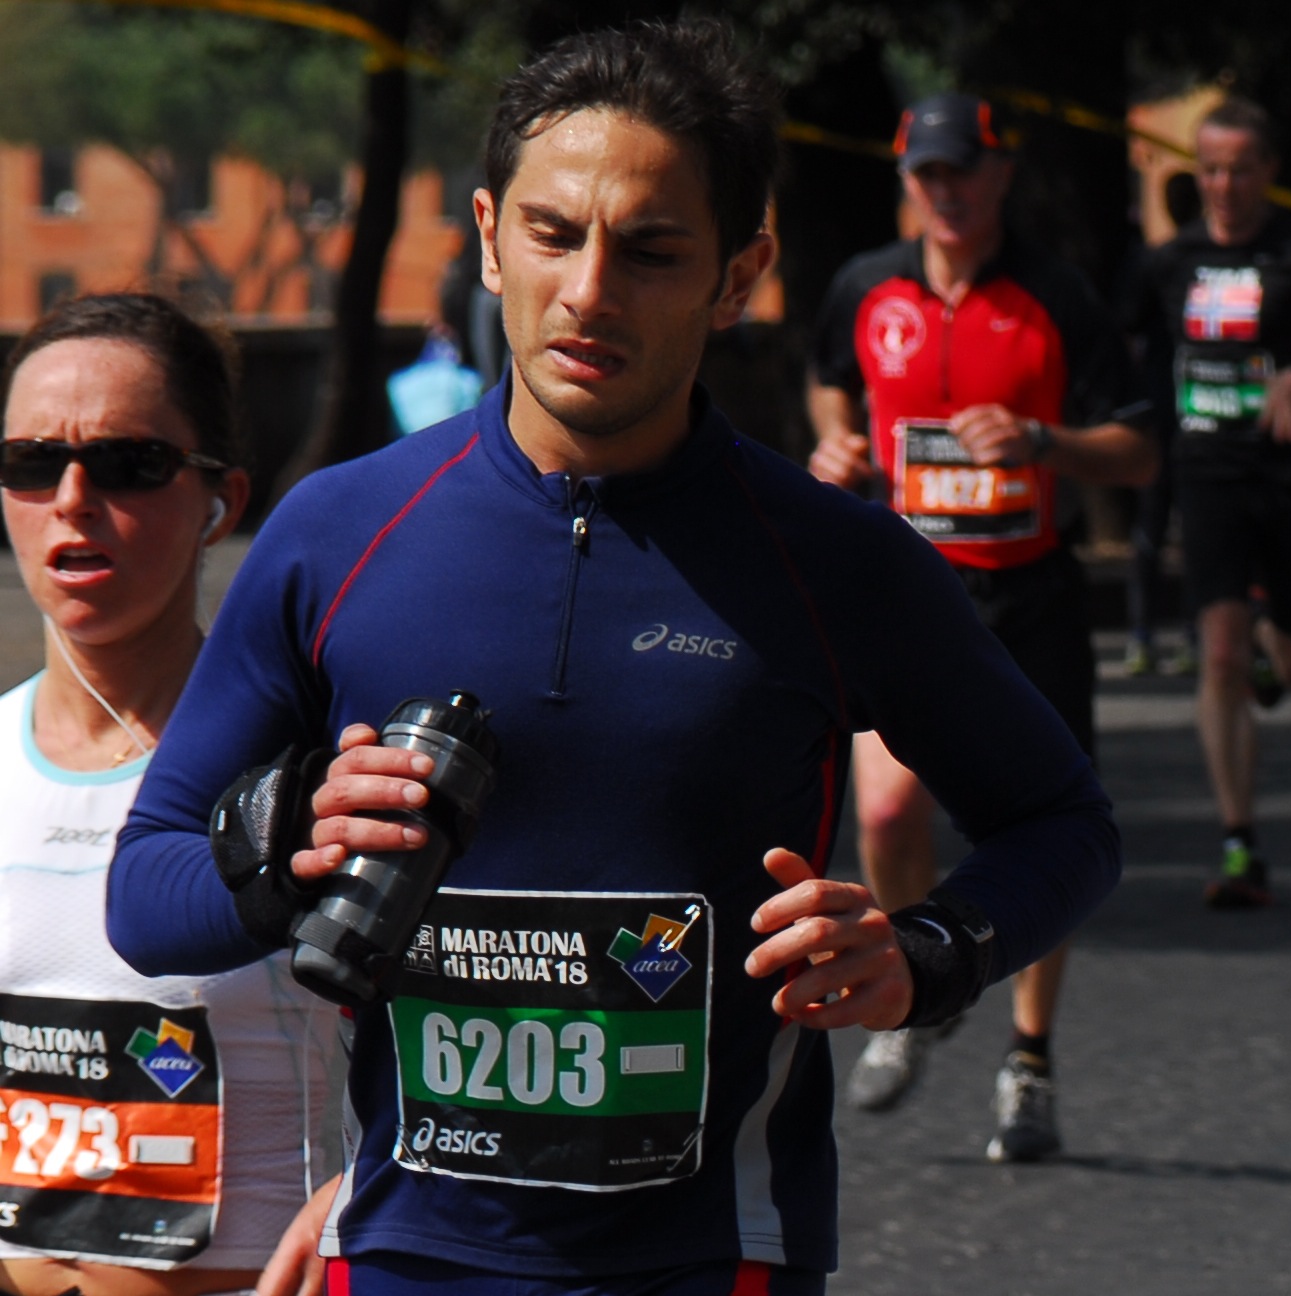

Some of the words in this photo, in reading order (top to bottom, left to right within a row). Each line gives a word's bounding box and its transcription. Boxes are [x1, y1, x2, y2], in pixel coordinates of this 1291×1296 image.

[441, 927, 587, 957] MARATONA
[443, 954, 468, 979] di
[633, 958, 679, 973] acea
[422, 1011, 606, 1107] 6203
